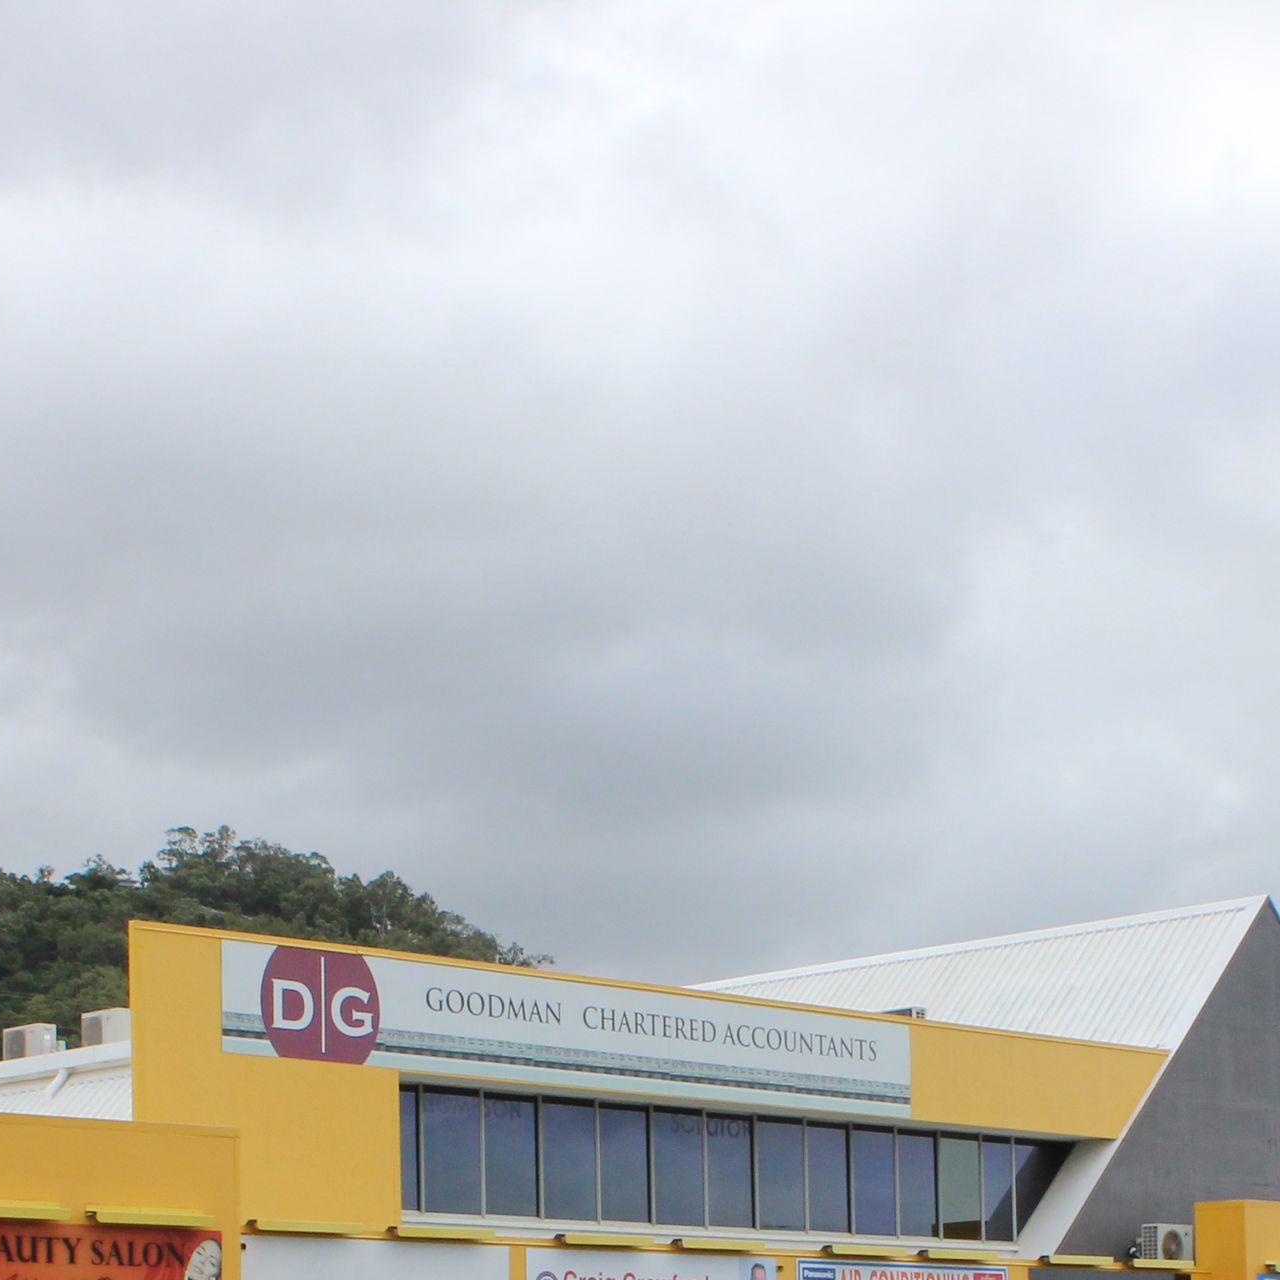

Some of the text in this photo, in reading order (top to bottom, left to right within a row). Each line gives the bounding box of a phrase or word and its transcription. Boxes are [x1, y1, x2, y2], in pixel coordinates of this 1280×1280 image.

[426, 986, 878, 1062] GOODMAN CHARTERED ACCOUNTANTS
[91, 1238, 185, 1268] SALON
